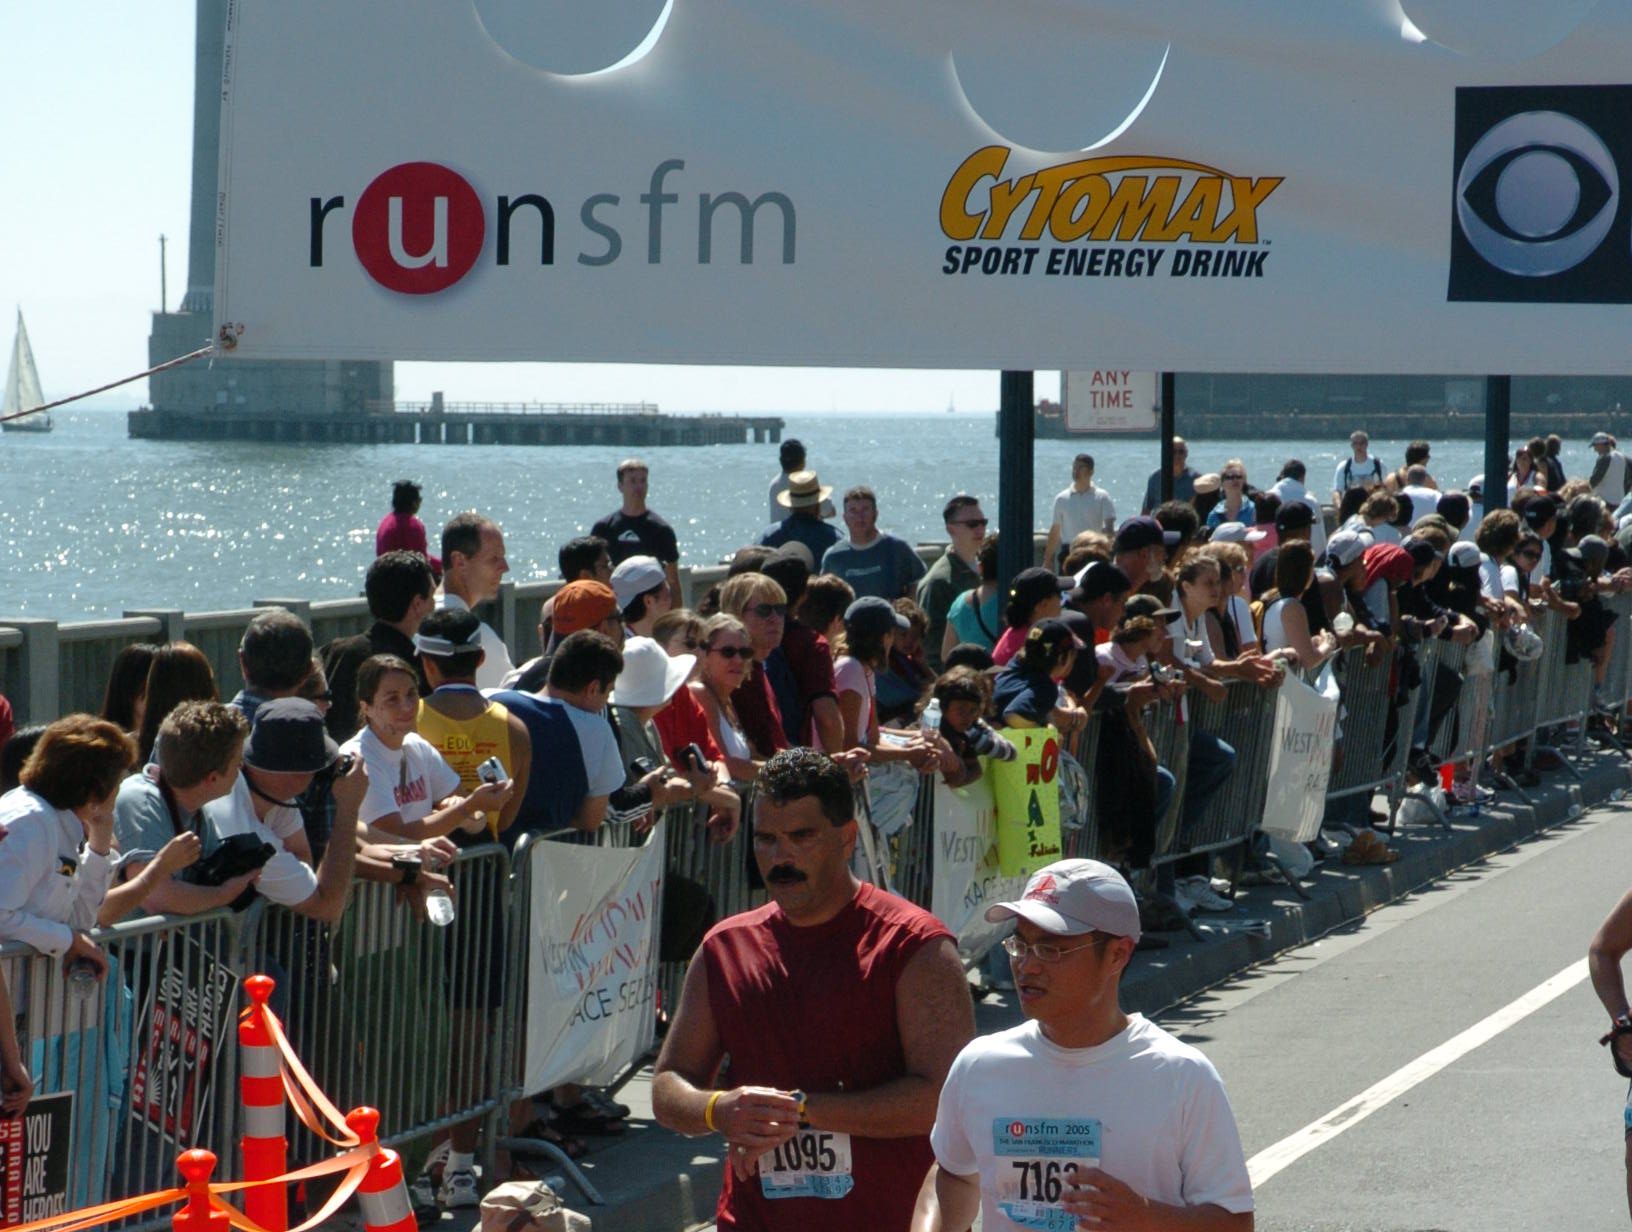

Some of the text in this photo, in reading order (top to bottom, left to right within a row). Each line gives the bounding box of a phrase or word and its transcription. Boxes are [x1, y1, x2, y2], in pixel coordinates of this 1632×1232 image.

[310, 159, 796, 270] runsfm
[942, 246, 1270, 277] SPORT ENERGY DRINK
[1091, 370, 1130, 386] ANY
[1089, 390, 1133, 409] TIME
[26, 1112, 52, 1154] YOU
[1006, 1121, 1090, 1136] runsfm 2005
[773, 1133, 836, 1172] 1095
[23, 1155, 48, 1197] ARE
